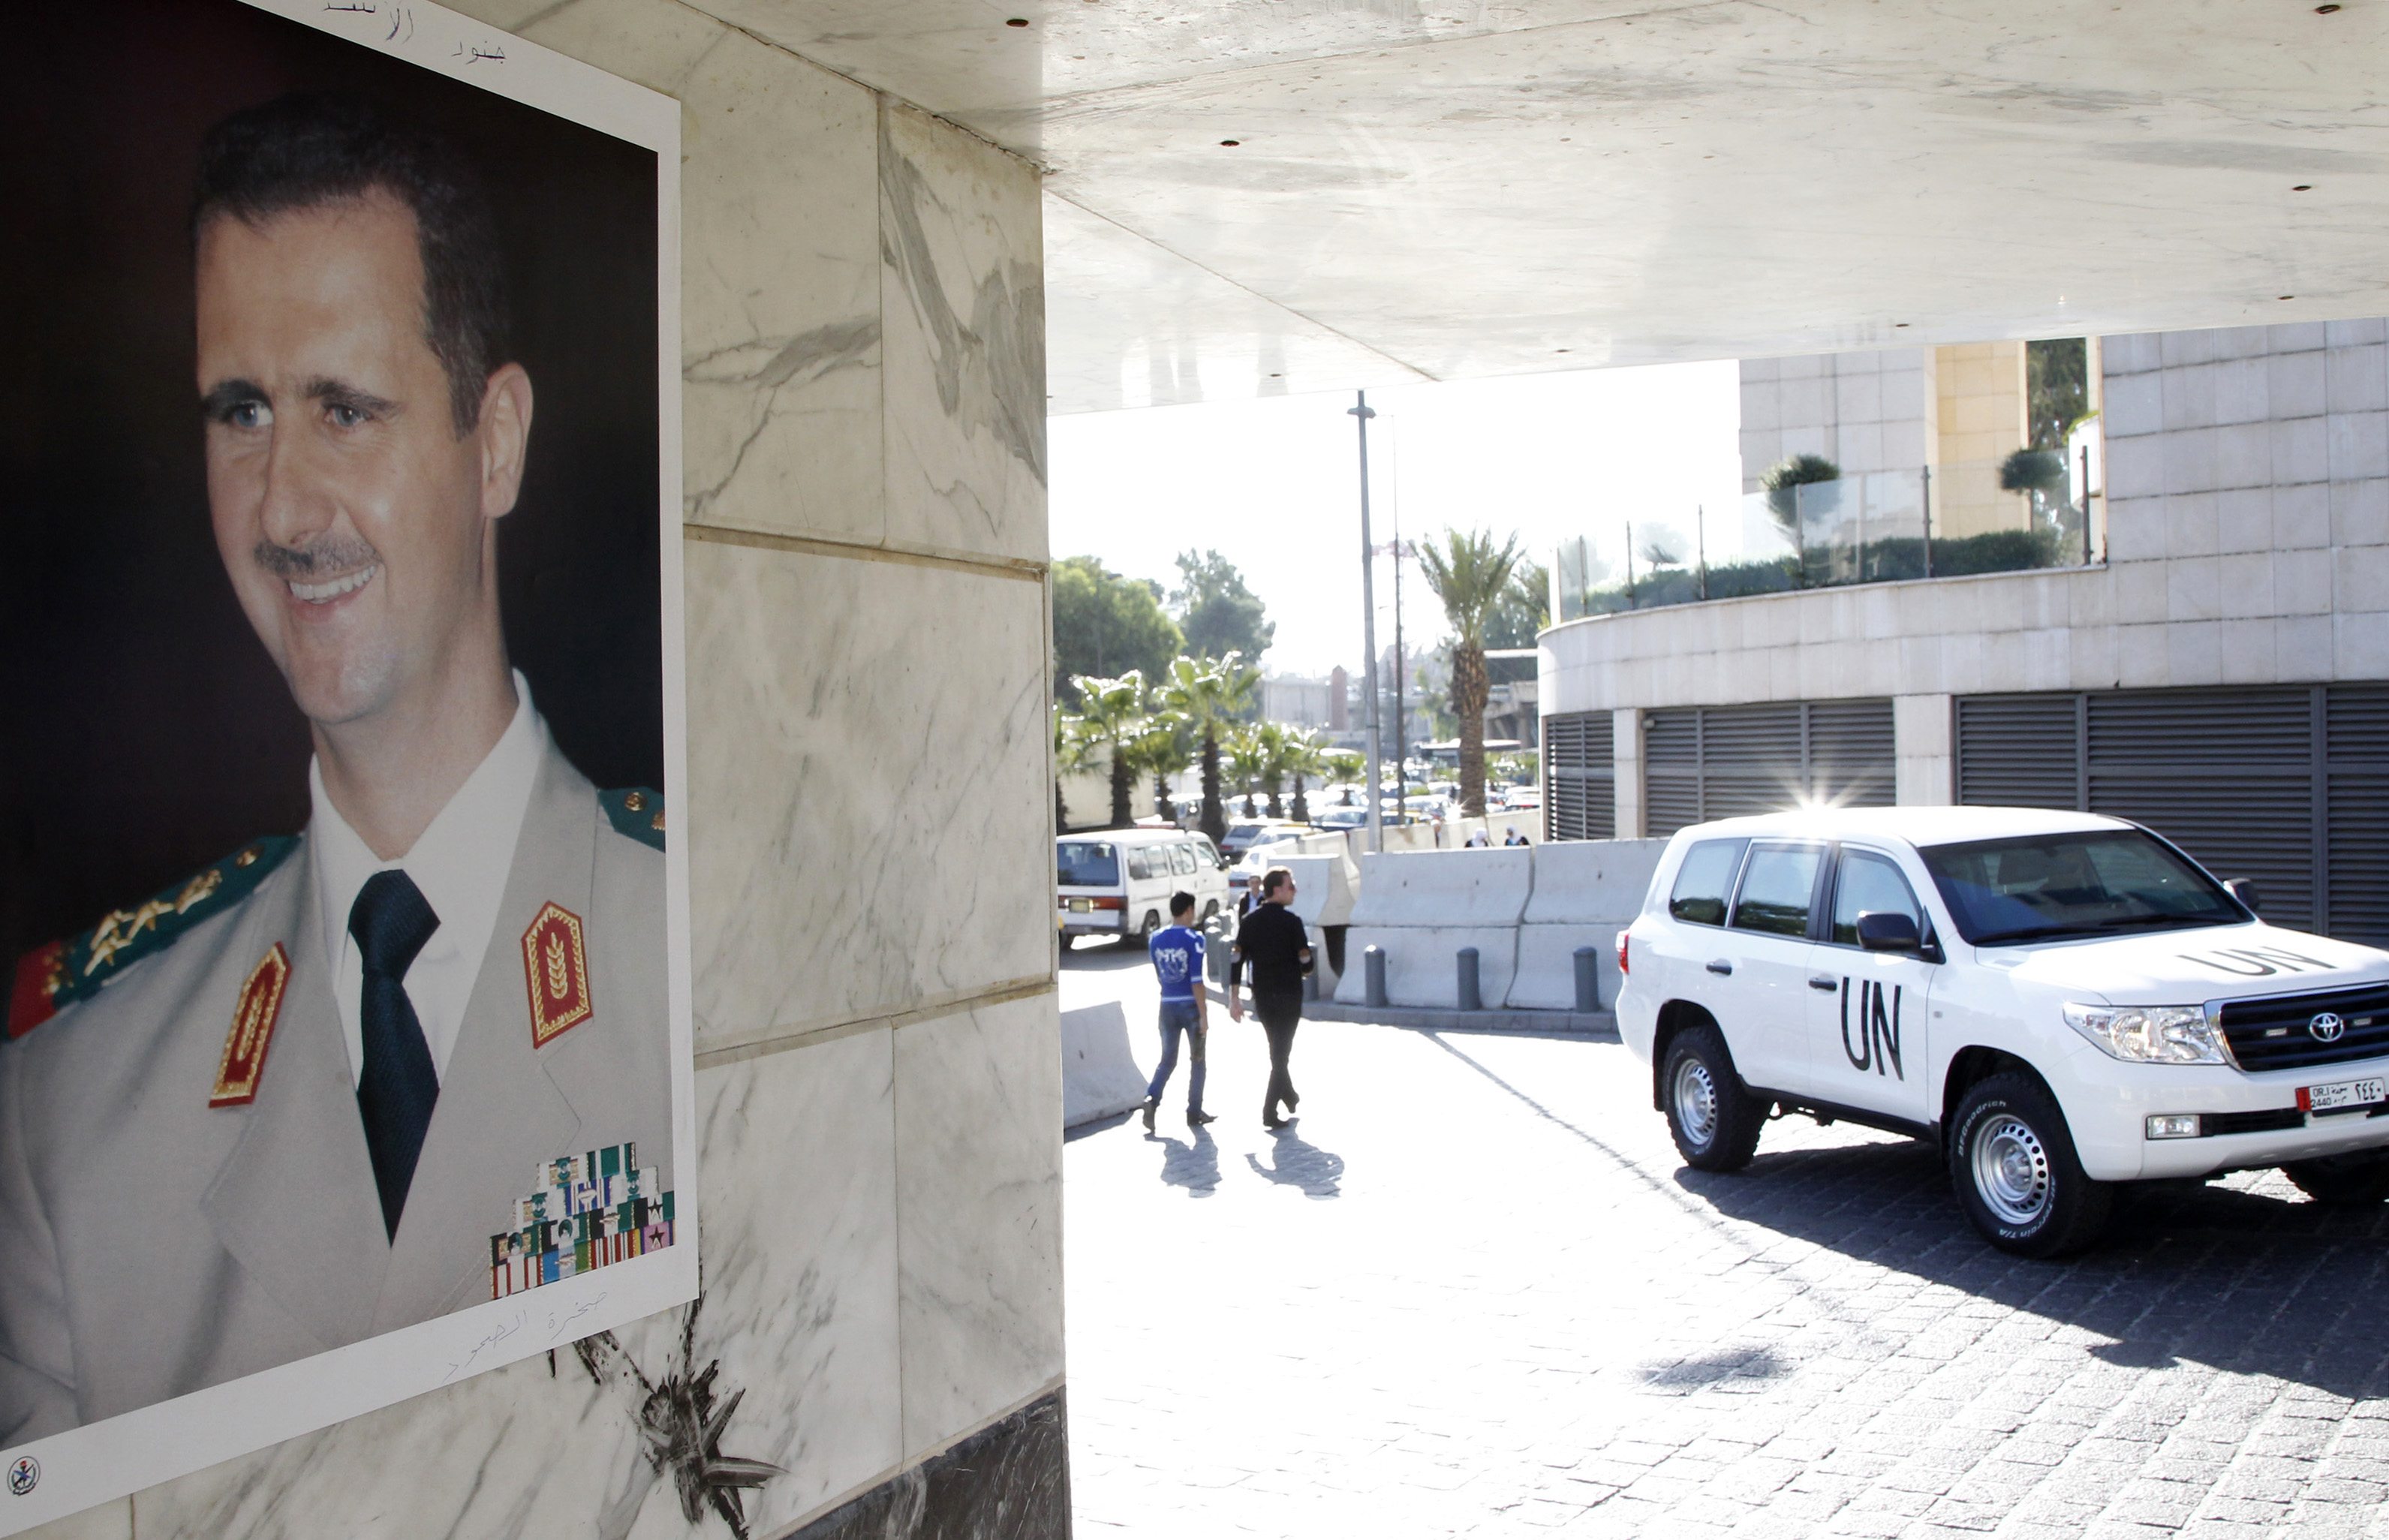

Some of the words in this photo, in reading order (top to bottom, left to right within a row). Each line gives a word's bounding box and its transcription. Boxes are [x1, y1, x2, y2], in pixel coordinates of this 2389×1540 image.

[2174, 946, 2339, 976] UN
[1840, 976, 1905, 1082] UN
[2311, 1098, 2331, 1108] 2440
[1958, 1100, 2006, 1157] BFGoodrich
